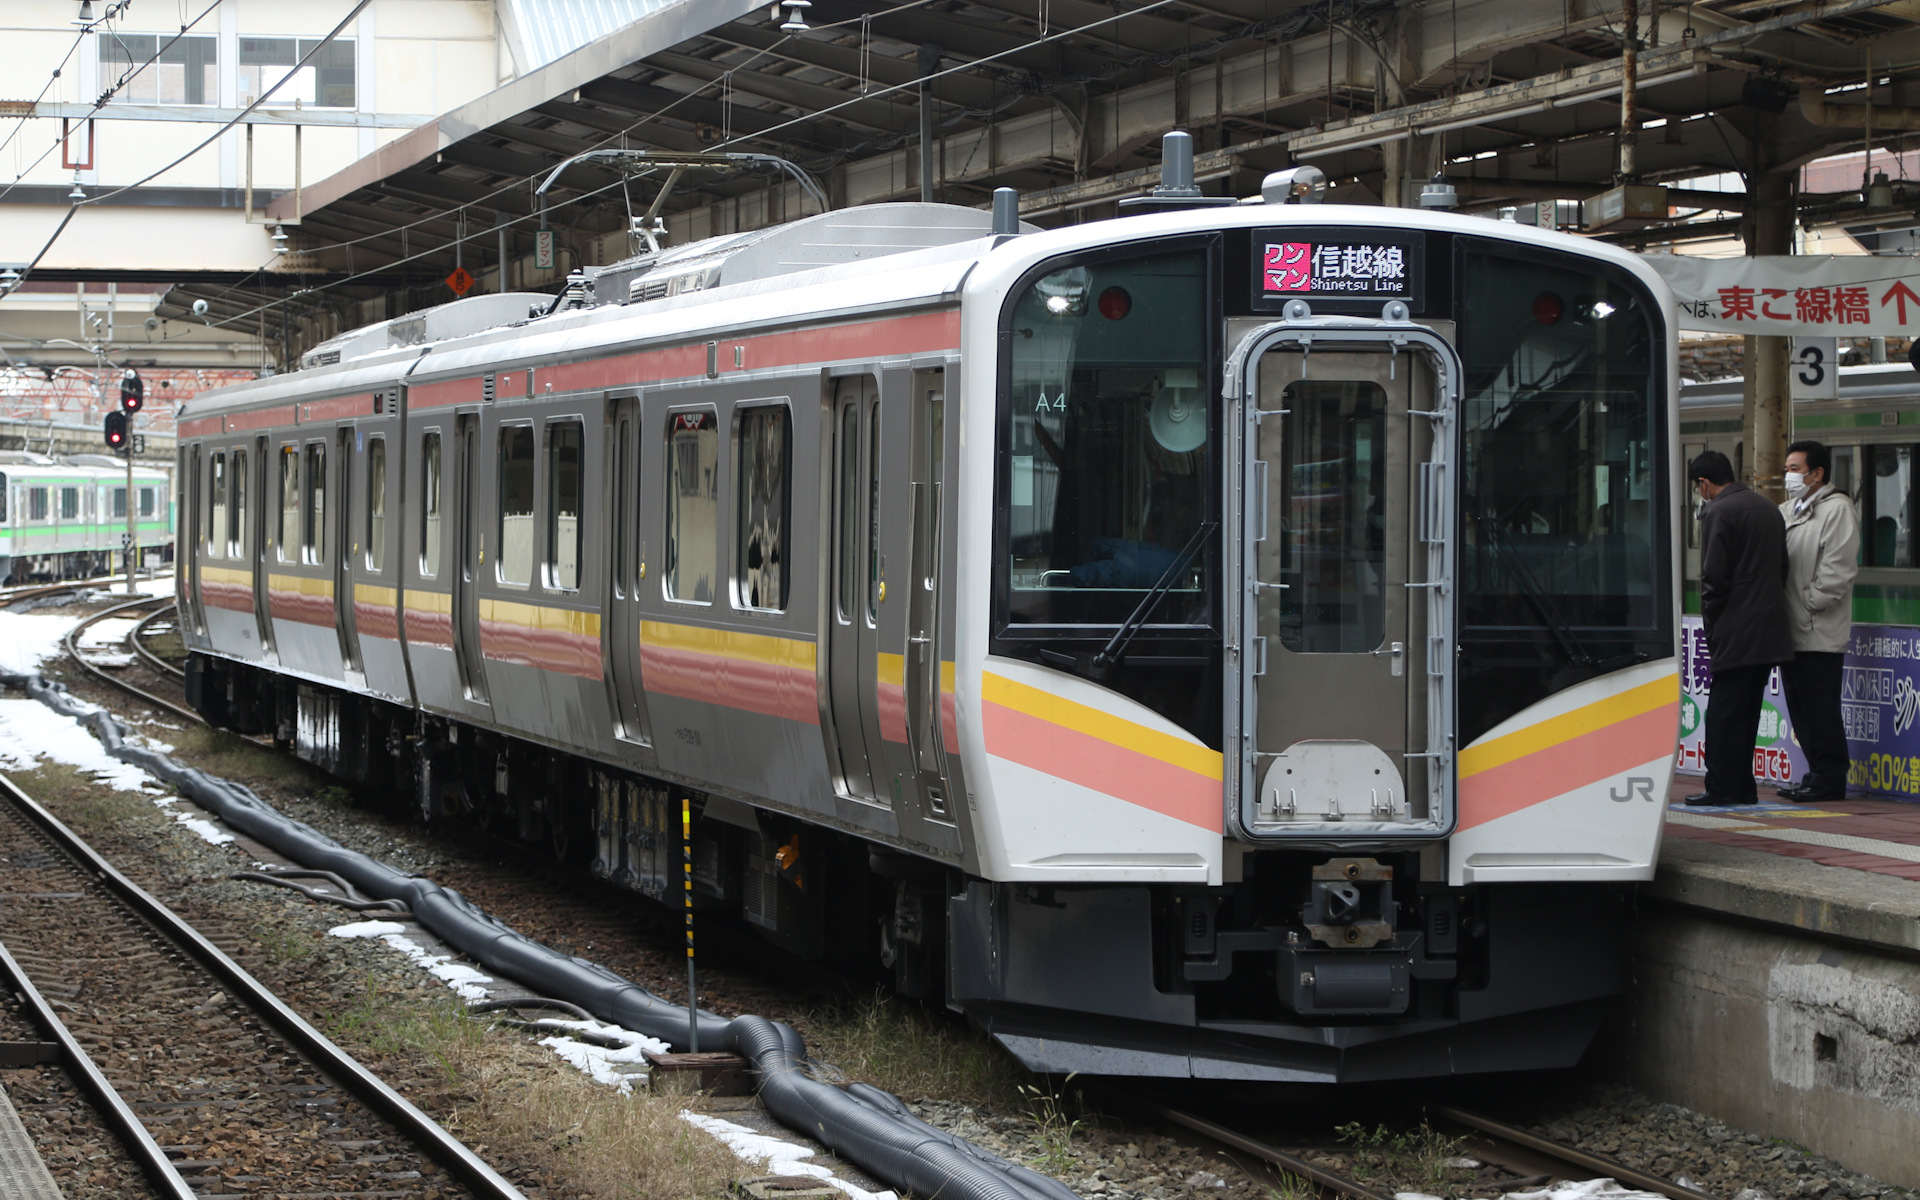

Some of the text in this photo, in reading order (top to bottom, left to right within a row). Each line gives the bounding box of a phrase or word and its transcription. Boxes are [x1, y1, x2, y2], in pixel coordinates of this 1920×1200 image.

[539, 232, 550, 267] ワンマン
[1311, 244, 1405, 279] 信越線
[1310, 277, 1404, 292] Shinetsu Line
[1798, 346, 1825, 386] 3
[1034, 392, 1067, 412] A4
[1609, 777, 1655, 803] JR
